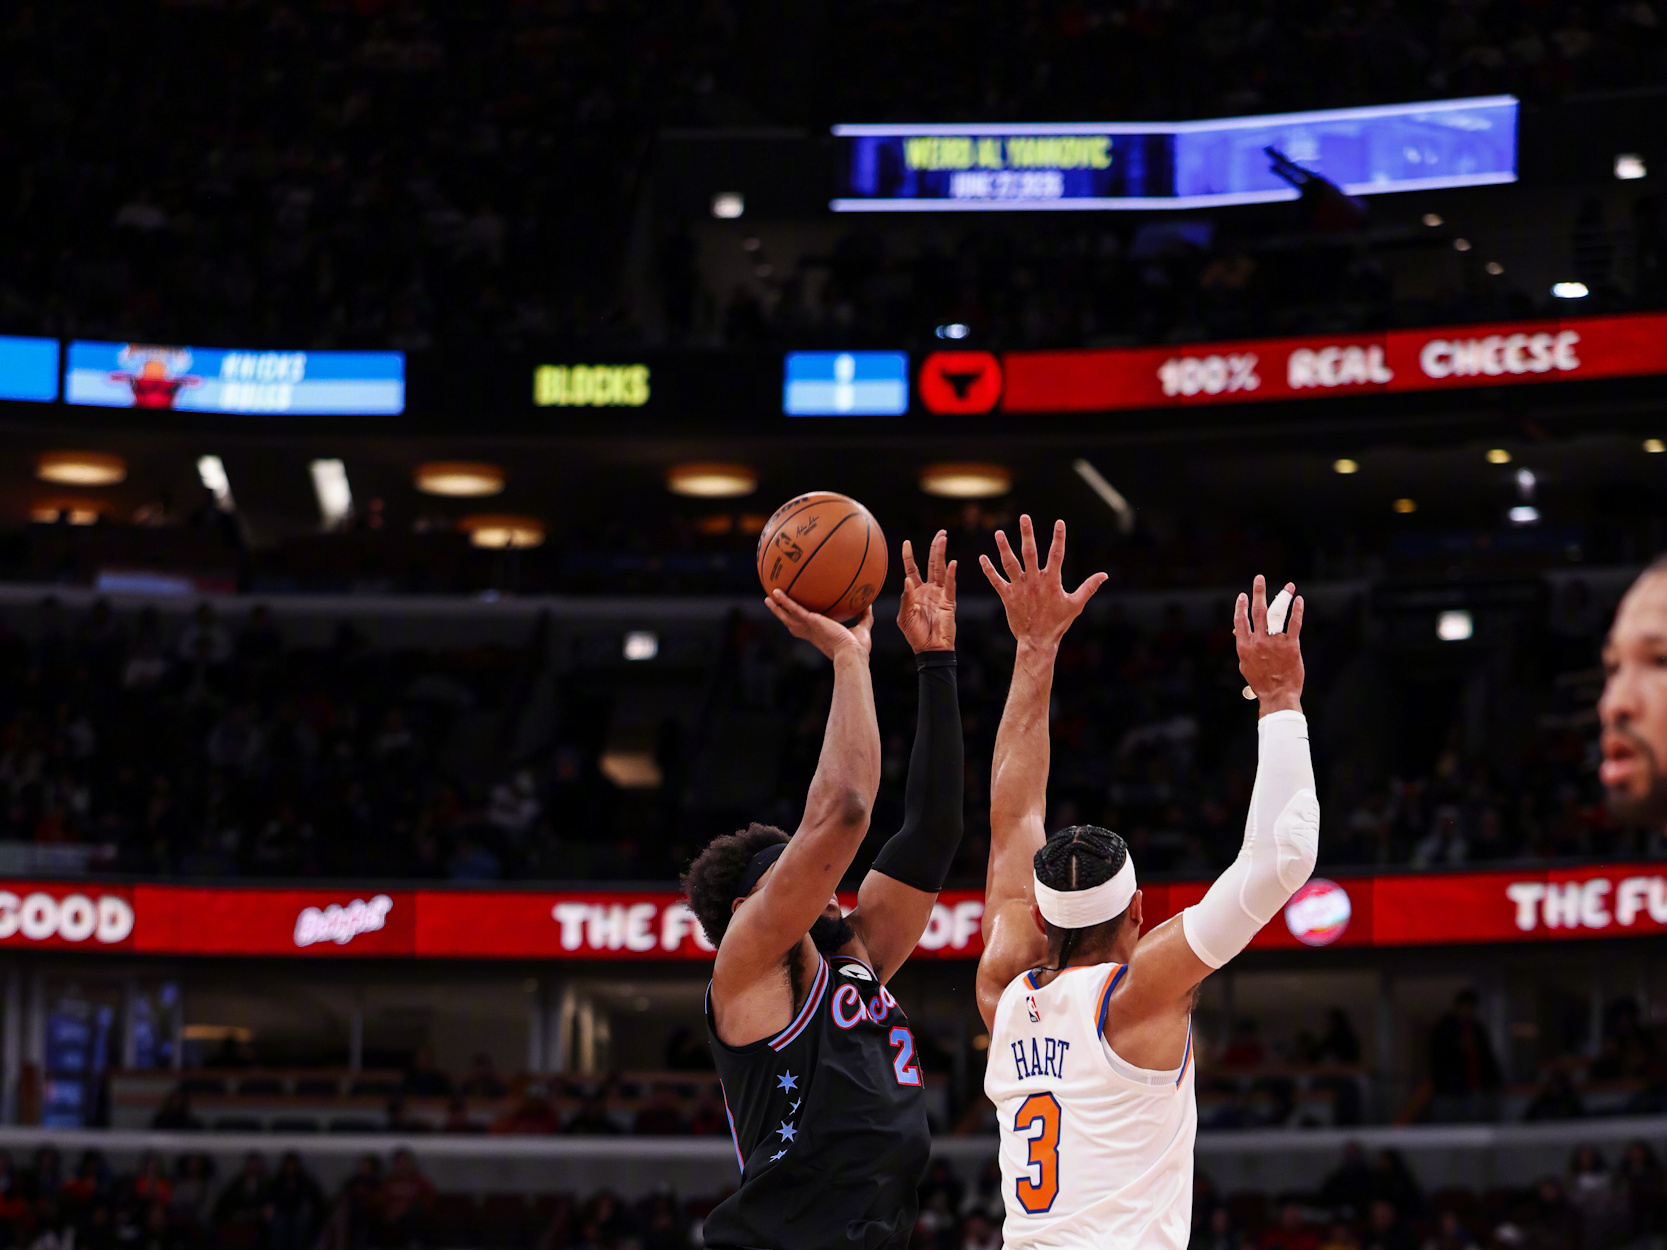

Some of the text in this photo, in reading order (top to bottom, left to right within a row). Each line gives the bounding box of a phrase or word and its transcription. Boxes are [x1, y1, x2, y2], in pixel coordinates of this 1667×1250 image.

[534, 364, 650, 406] BLOCKS
[1158, 331, 1580, 396] 100% REAL CHEESE
[552, 902, 658, 951] THE
[918, 901, 985, 951] OF
[1505, 878, 1613, 931] THE
[889, 1026, 923, 1087] 2
[1011, 1036, 1070, 1081] HART
[1013, 1091, 1062, 1214] 3
